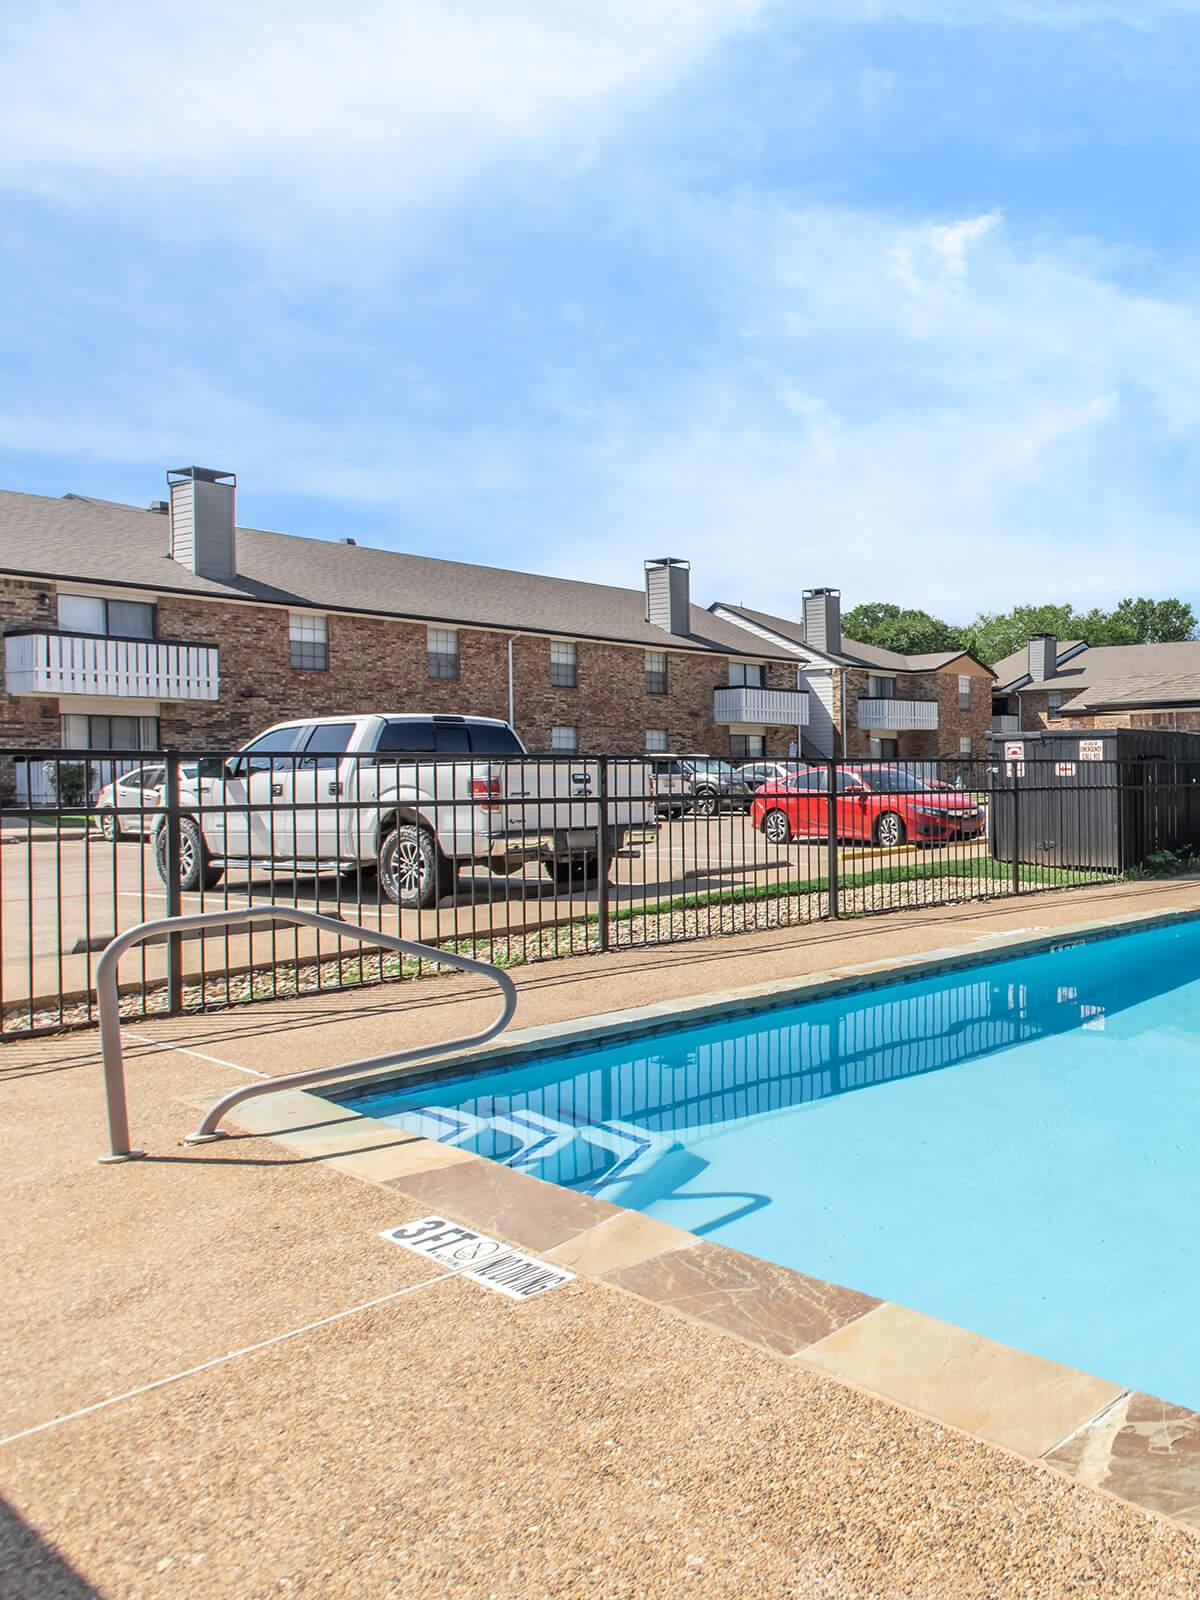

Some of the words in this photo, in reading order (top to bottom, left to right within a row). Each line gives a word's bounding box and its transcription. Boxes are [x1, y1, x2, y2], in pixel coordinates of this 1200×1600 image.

[392, 1220, 446, 1239] 3
[468, 1254, 524, 1277] NO
[486, 1261, 567, 1296] DIVING
